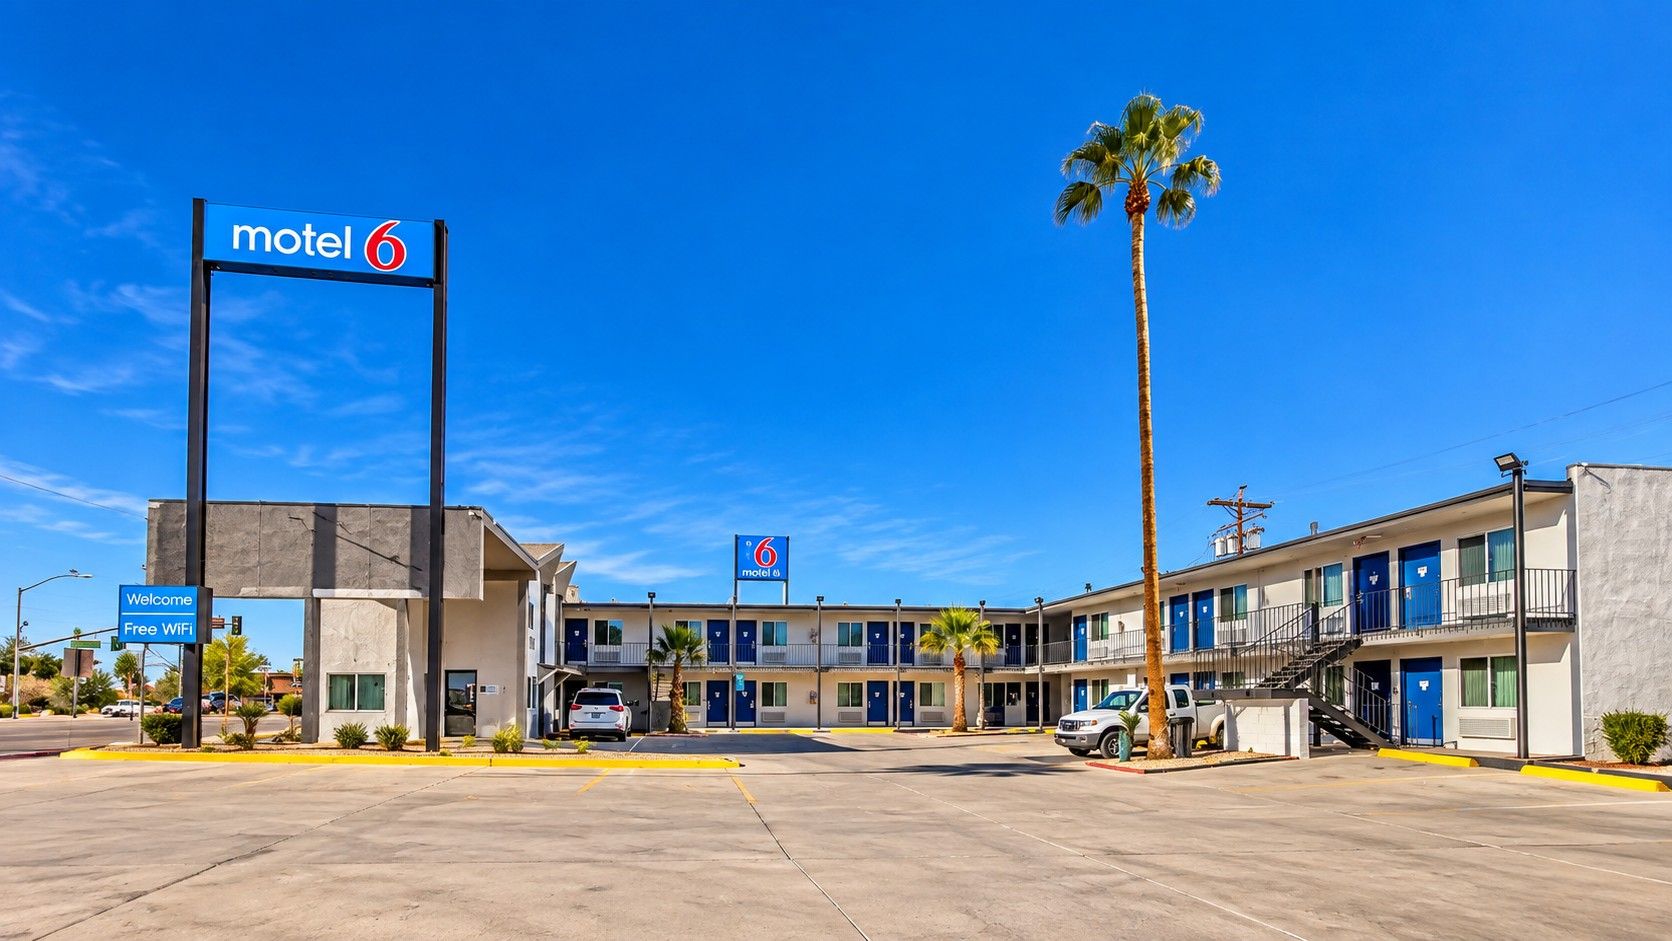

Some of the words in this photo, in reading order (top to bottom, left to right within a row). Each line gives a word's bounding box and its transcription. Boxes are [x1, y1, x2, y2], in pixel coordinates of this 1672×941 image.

[232, 223, 352, 259] motel
[364, 219, 407, 272] 6
[754, 536, 778, 568] 6
[127, 593, 193, 606] Welcome
[124, 622, 157, 636] Free
[161, 622, 193, 636] WiFi
